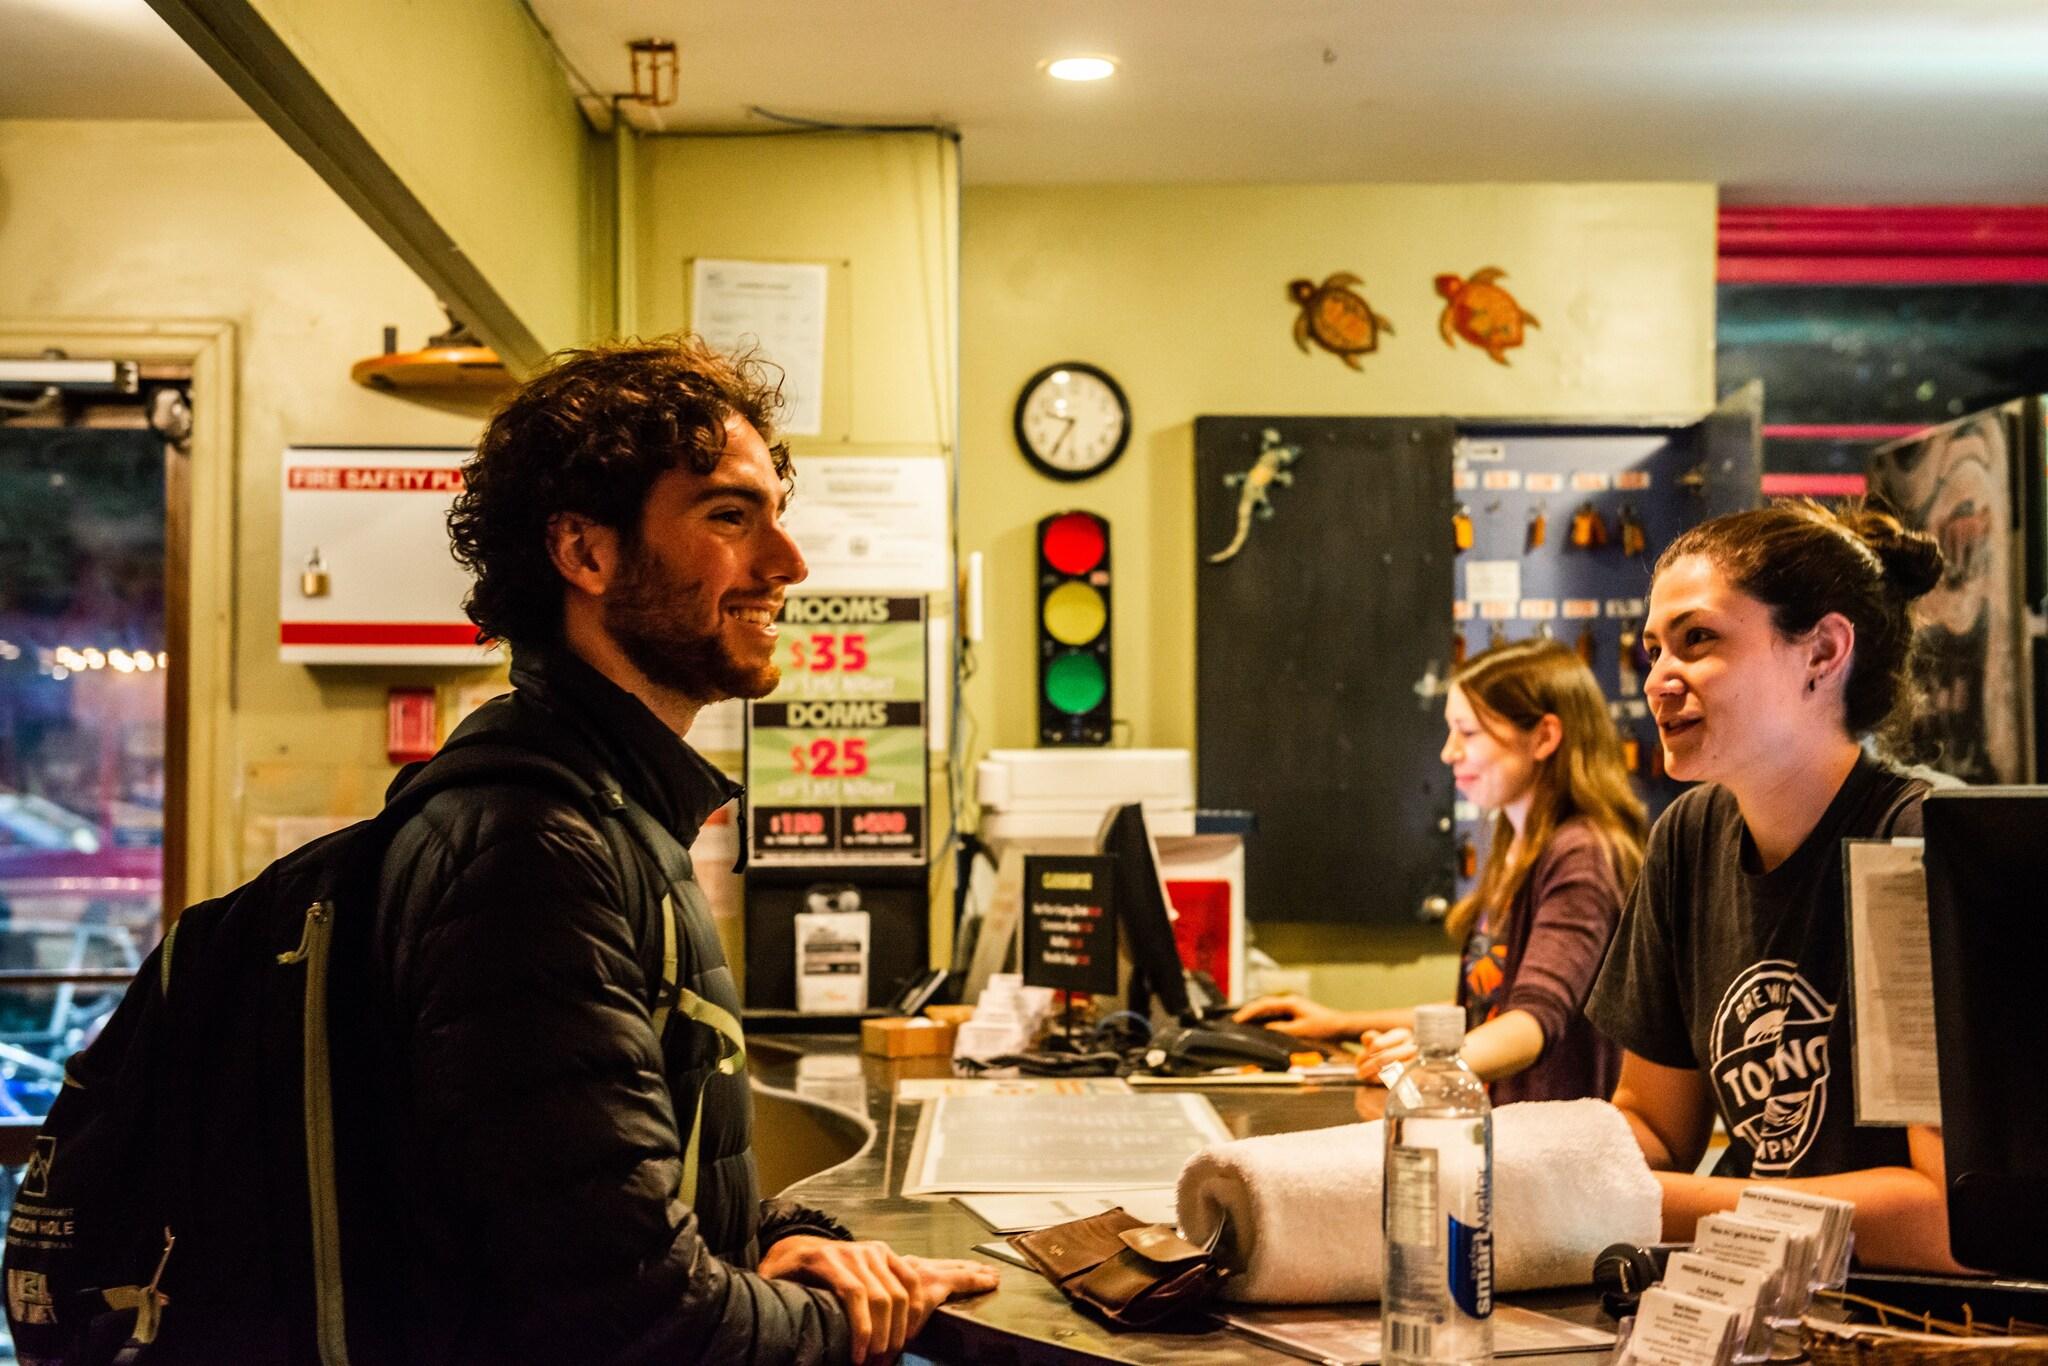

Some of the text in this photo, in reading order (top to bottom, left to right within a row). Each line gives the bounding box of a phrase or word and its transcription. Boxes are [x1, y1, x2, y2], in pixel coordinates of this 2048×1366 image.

[293, 470, 338, 488] FIRE
[346, 470, 427, 488] SAFETY
[784, 598, 889, 622] ROOMS
[789, 634, 868, 672] $35
[786, 703, 888, 726] DORMS
[790, 738, 868, 777] $25
[39, 1220, 75, 1235] HOLE
